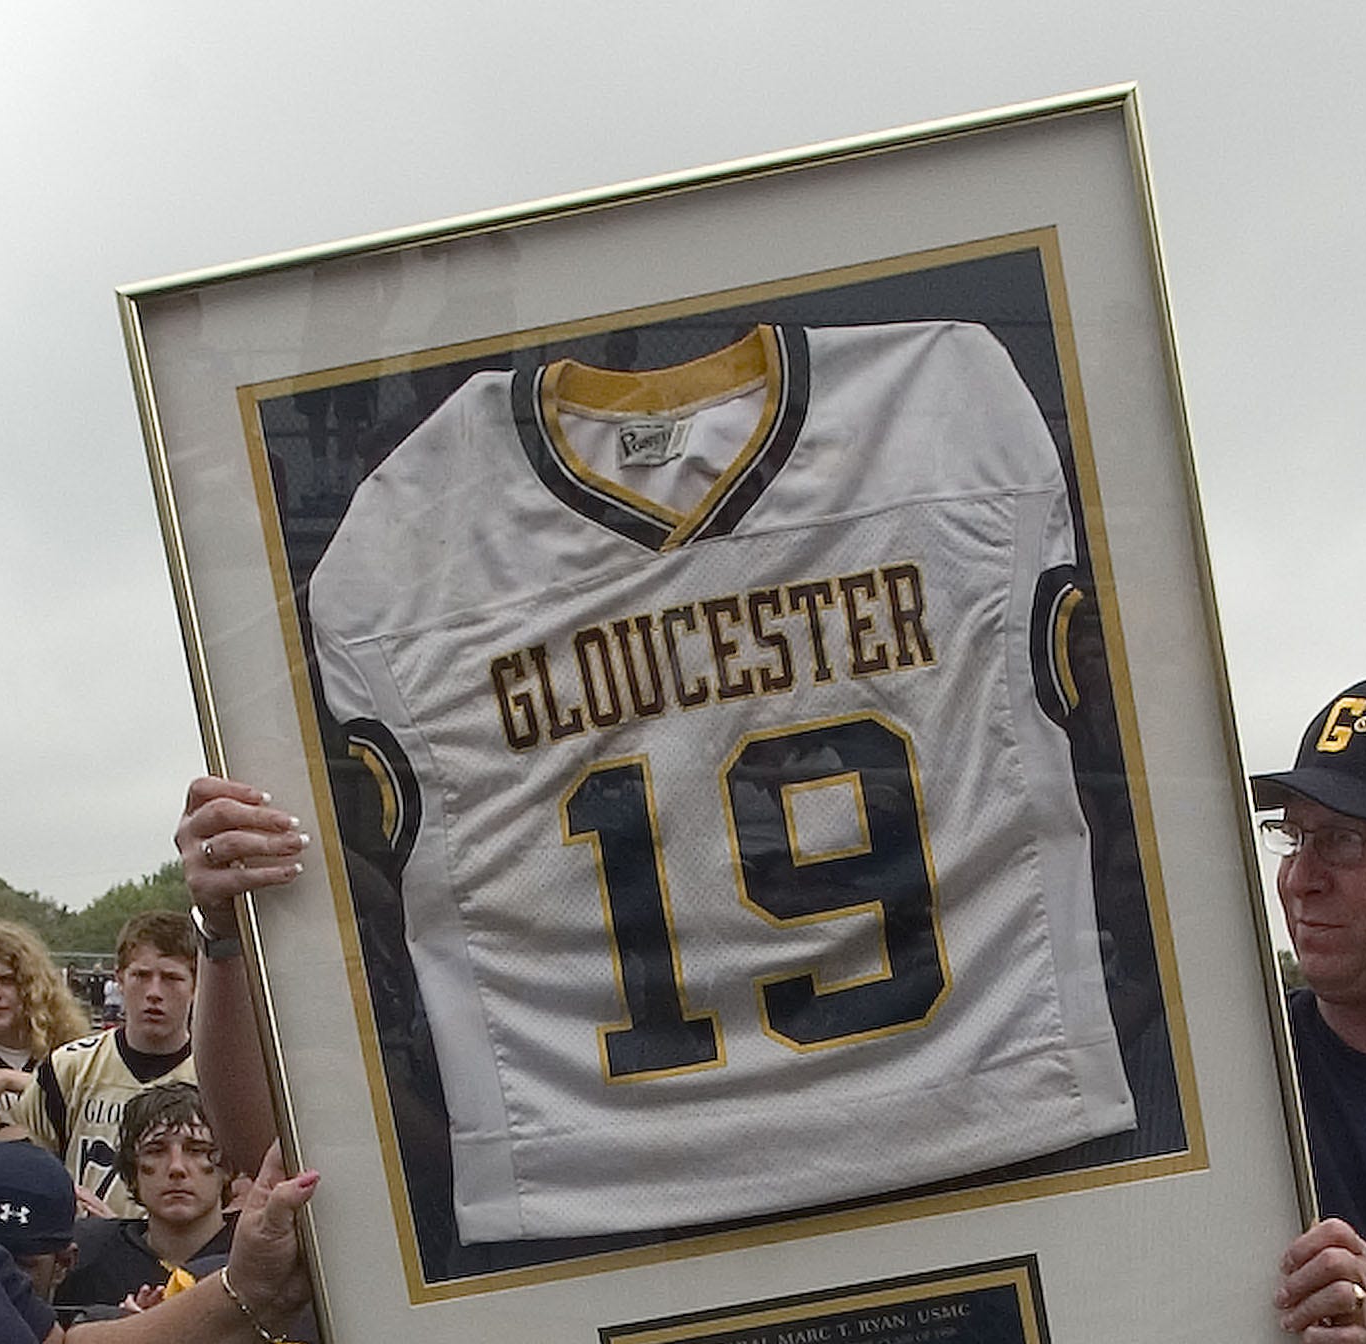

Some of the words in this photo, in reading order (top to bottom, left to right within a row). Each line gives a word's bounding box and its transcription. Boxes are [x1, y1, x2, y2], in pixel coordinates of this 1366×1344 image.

[490, 560, 936, 753] GLOUCESTER
[558, 709, 953, 1086] 19
[916, 1300, 970, 1323] USMC
